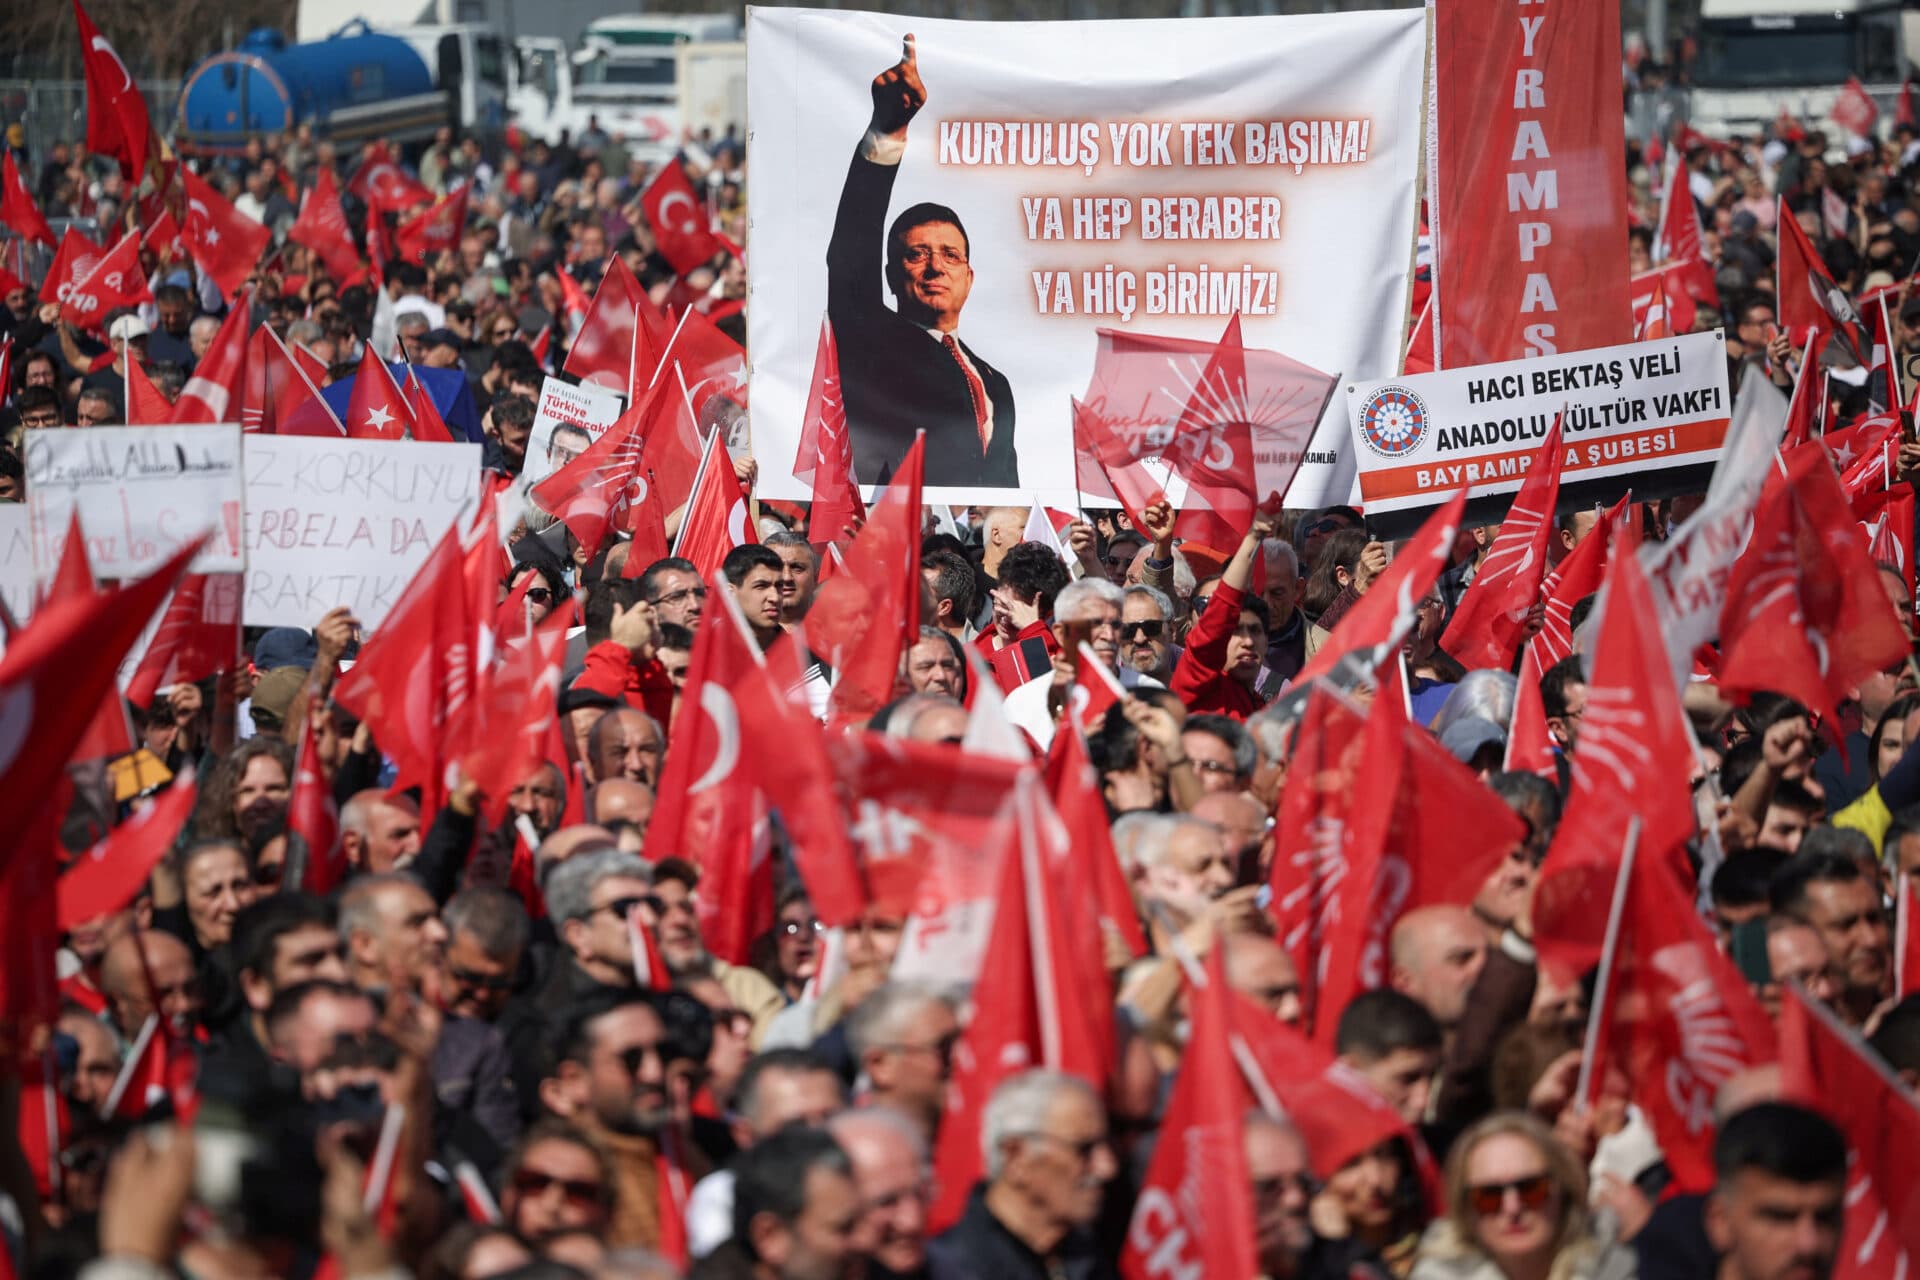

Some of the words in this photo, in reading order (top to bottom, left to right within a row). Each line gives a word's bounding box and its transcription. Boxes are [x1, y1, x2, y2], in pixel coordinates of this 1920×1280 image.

[939, 121, 1100, 176] KURTULUŞ
[1109, 123, 1173, 166] YOK
[1179, 123, 1238, 166] TEK
[1244, 120, 1369, 175] BAŞINA!
[1022, 198, 1065, 240] YA
[1073, 198, 1132, 240] HEP
[1140, 197, 1281, 240] BERABER
[1032, 271, 1075, 314] YA
[1083, 264, 1136, 322] HİÇ
[1145, 264, 1278, 315] BİRİMİZ!
[1468, 375, 1524, 404] HACI
[1532, 360, 1623, 395] BEKTAŞ
[1629, 346, 1681, 380] VELİ
[546, 394, 587, 418] Türkiye
[1436, 415, 1546, 451] ANADOLU
[1653, 387, 1721, 418] VAKFI
[293, 451, 473, 504] KORKUYU
[1416, 453, 1580, 488] BAYRAMPA
[1588, 428, 1676, 466] ŞUBESİ
[245, 507, 434, 555] ERBELA'DA
